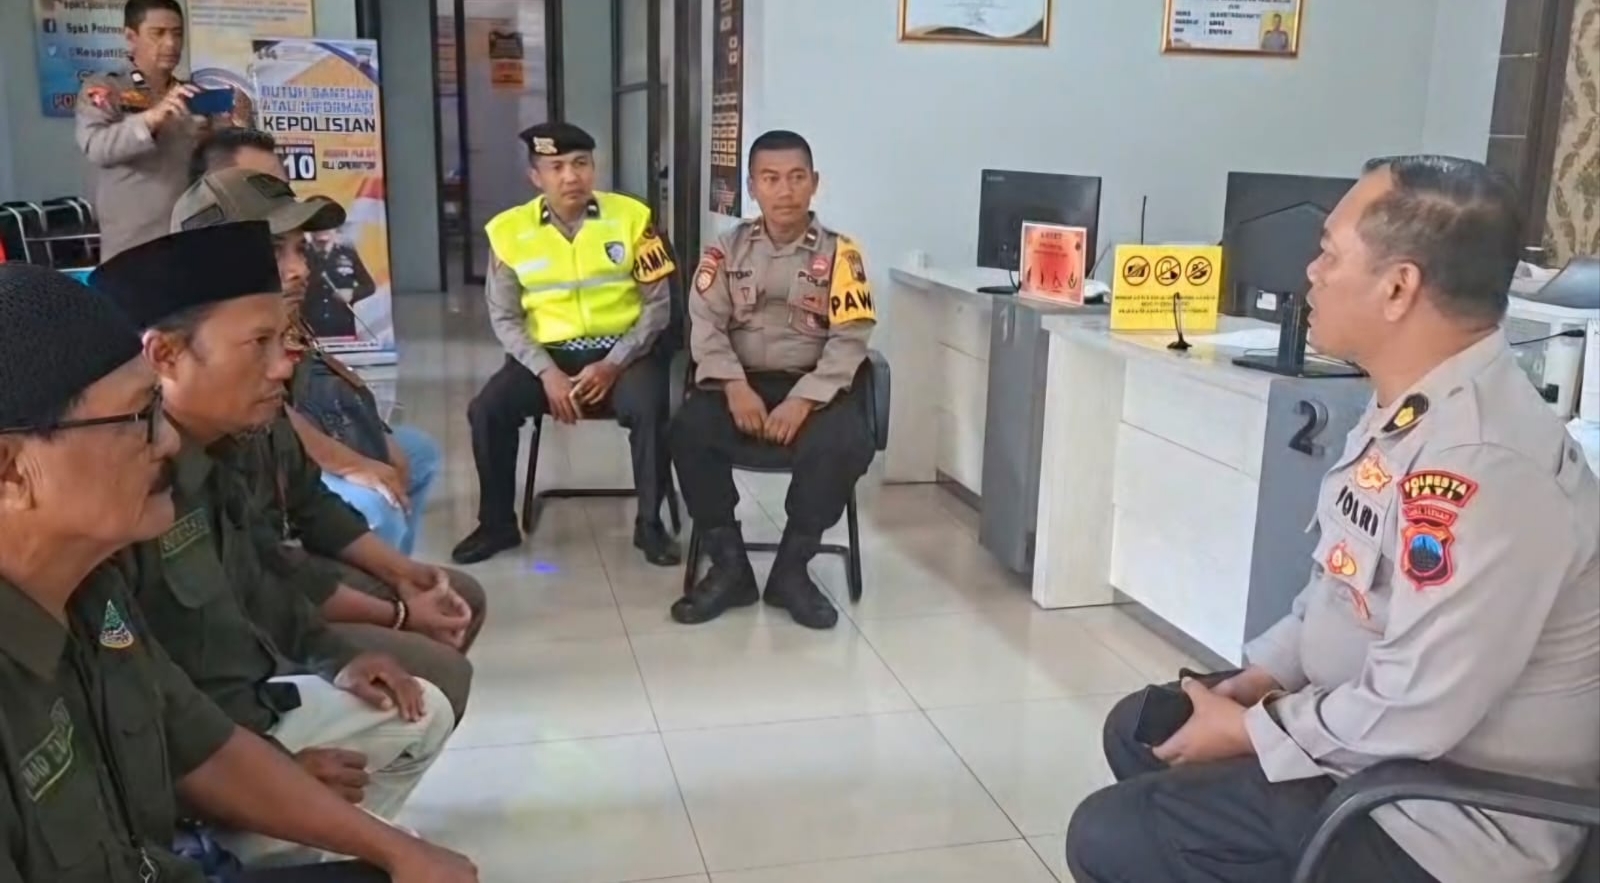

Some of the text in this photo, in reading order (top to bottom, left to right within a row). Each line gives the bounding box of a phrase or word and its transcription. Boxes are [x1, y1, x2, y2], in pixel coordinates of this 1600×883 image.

[263, 116, 376, 133] KEPOLISIAN
[831, 291, 875, 316] PAW
[1288, 399, 1327, 456] 2
[1403, 474, 1468, 497] POLRESTA
[1411, 485, 1454, 500] PATI
[1335, 485, 1379, 538] POLRI
